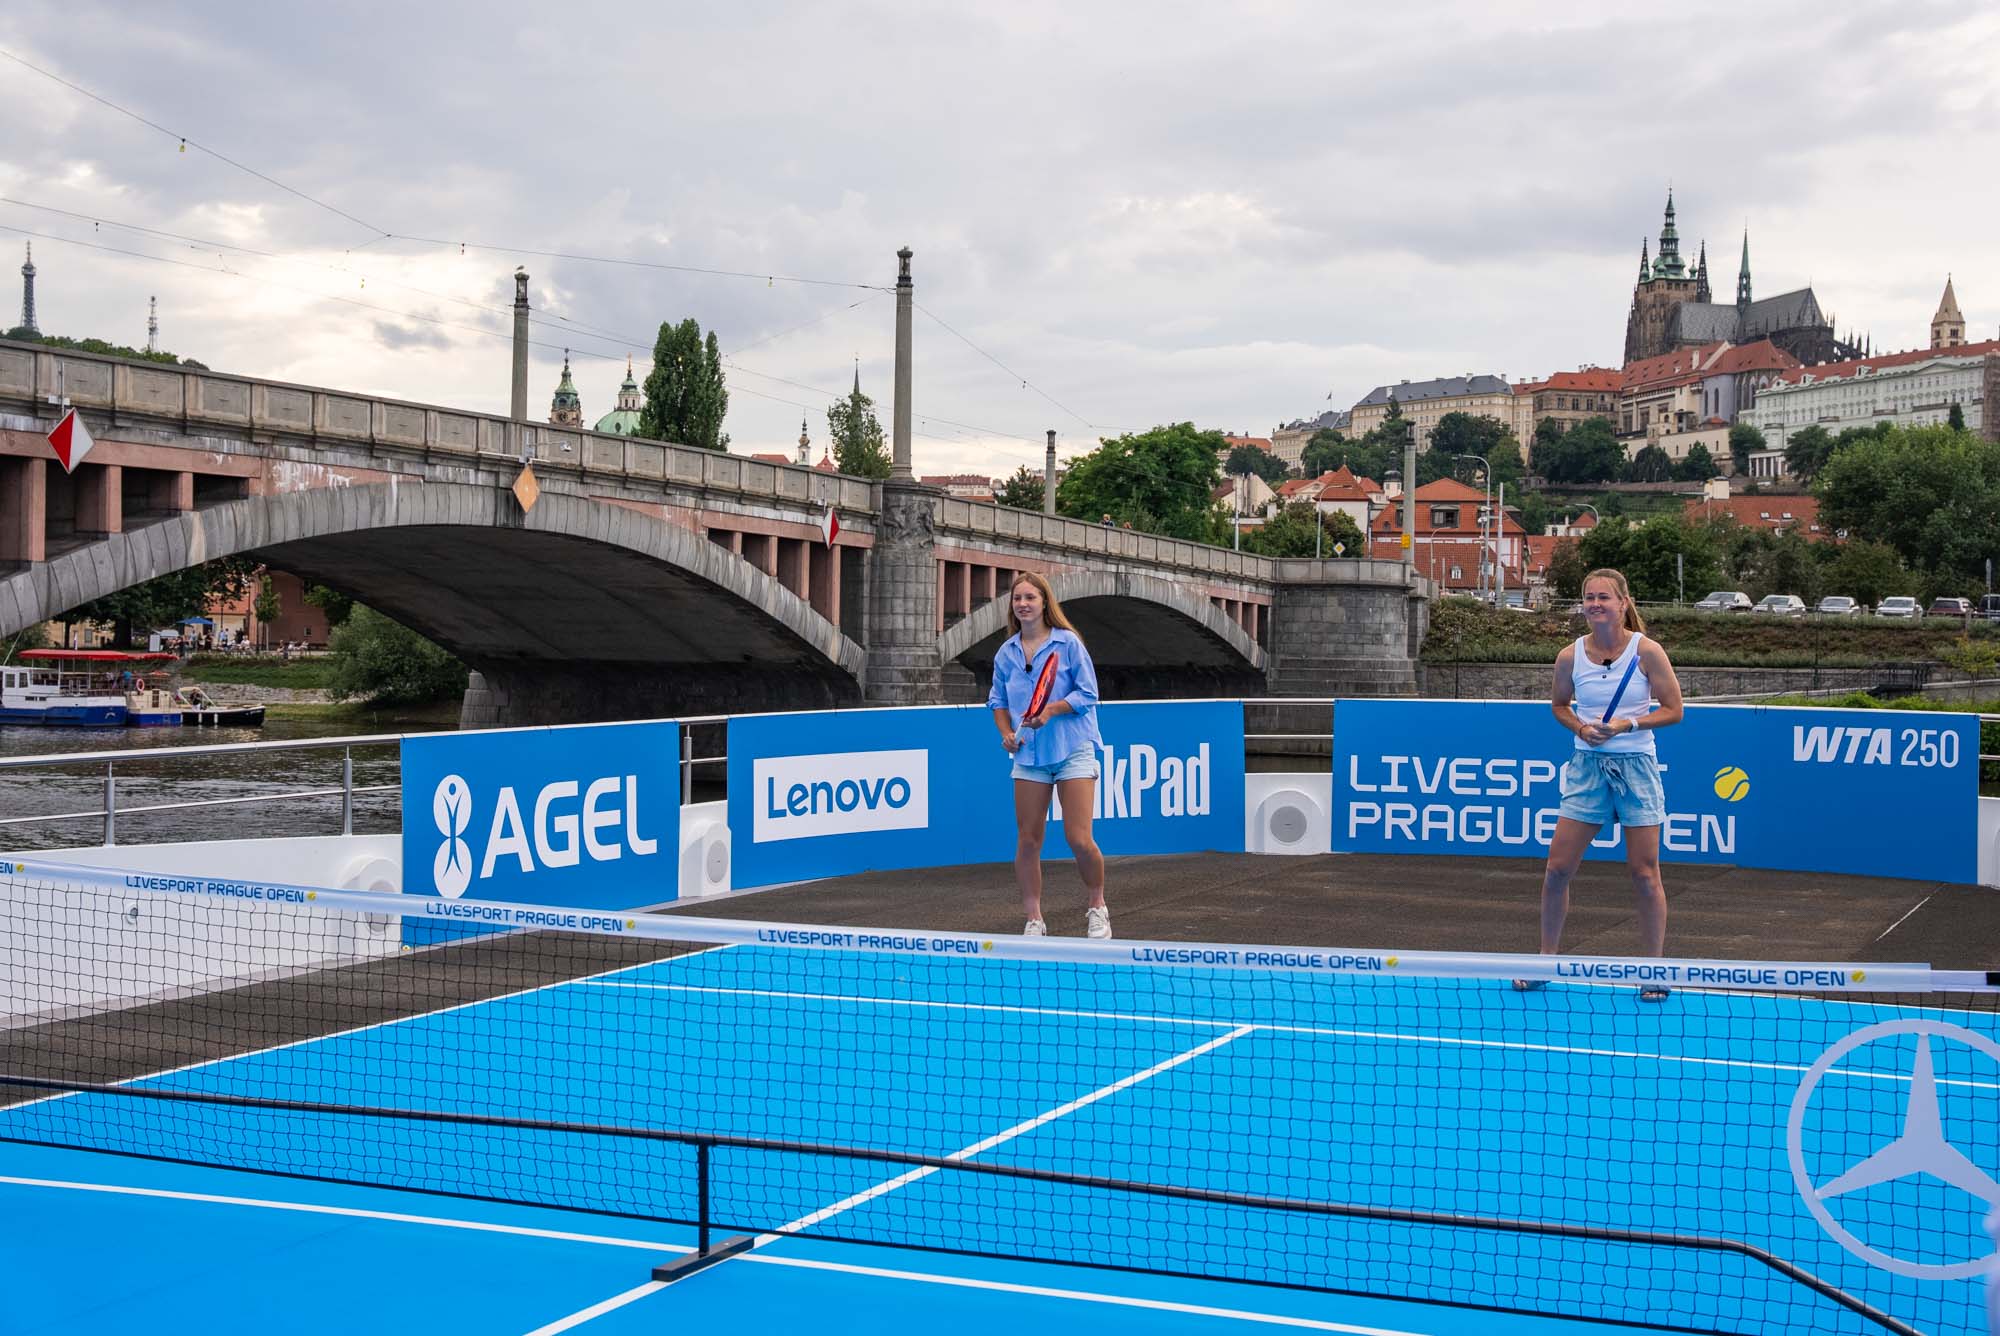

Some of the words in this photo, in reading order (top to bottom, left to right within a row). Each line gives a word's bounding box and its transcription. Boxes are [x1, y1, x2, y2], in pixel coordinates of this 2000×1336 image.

[1793, 725, 1892, 765] WTA
[1901, 729, 1959, 768] 250
[1009, 743, 1211, 821] kPad
[1349, 754, 1668, 797] LIVESP
[767, 776, 911, 820] Lenovo
[479, 775, 658, 879] AGEL
[1349, 801, 1564, 847] PRAGUE
[125, 874, 204, 894] LIVESPORT
[207, 882, 263, 900] PRAGUE
[266, 888, 305, 903] OPEN
[426, 902, 512, 922] LIVESPORT
[515, 910, 577, 928] PRAGUE
[581, 916, 623, 932] OPEN
[757, 929, 854, 947] LIVESPORT
[857, 935, 928, 952] PRAGUE
[931, 938, 979, 954] OPEN
[1131, 948, 1240, 965] LIVESPORT
[1244, 952, 1324, 969] PRAGUE
[1328, 955, 1382, 971] OPEN
[1556, 963, 1682, 982] LIVESPORT
[1687, 967, 1778, 985] PRAGUE
[1783, 970, 1846, 987] OPEN
